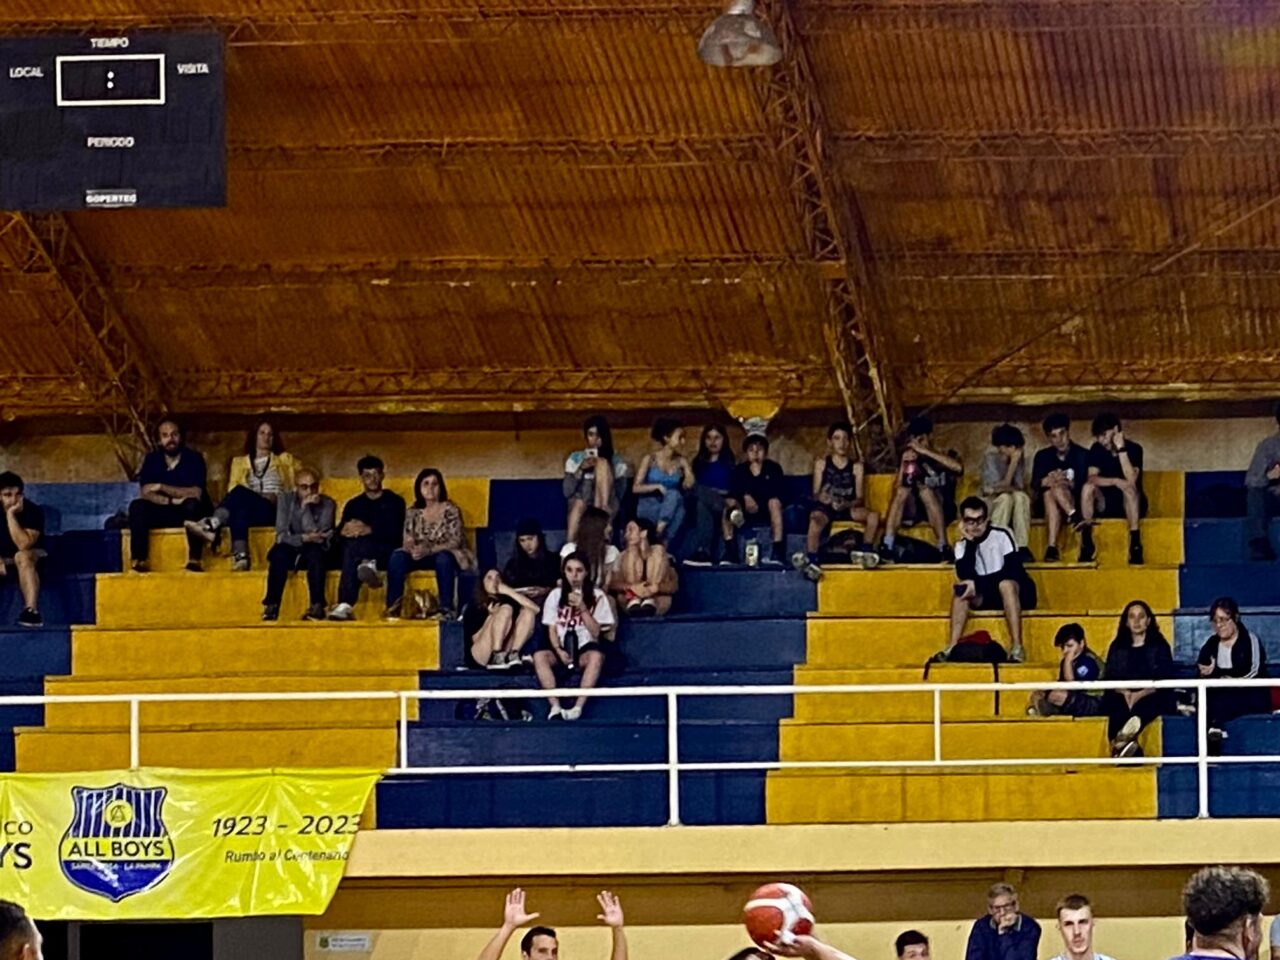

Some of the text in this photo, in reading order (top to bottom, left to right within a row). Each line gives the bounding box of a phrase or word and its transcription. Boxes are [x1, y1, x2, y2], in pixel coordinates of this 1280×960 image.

[90, 38, 129, 48] TIEMPO
[9, 67, 44, 78] LOCAL
[177, 63, 209, 74] VISITA
[87, 137, 135, 147] PERIODO
[212, 816, 268, 838] 1923
[298, 814, 361, 835] 2023
[68, 841, 165, 857] ALL BOYS
[224, 850, 265, 863] Rumbo
